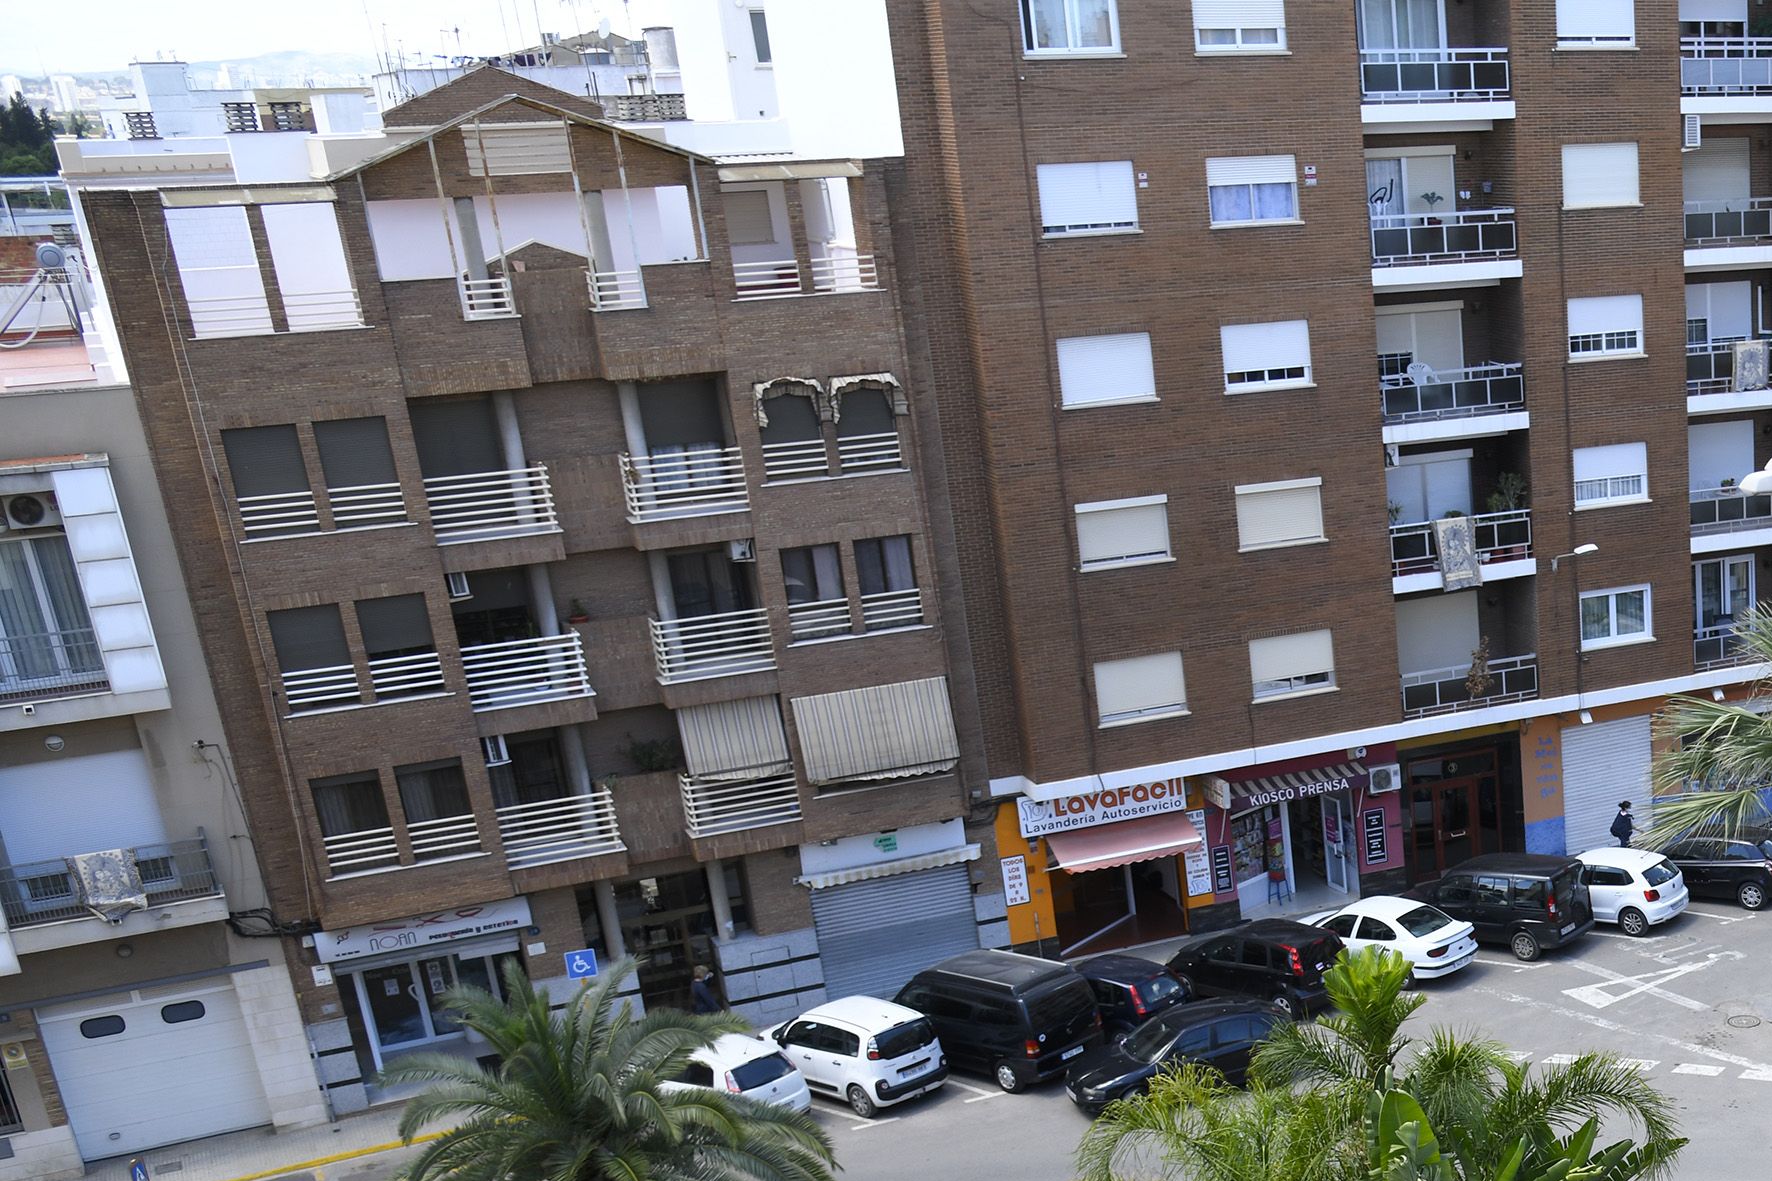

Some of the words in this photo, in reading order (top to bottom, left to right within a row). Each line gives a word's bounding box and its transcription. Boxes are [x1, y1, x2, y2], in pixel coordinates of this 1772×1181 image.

[1250, 788, 1295, 807] KIOSCO
[1299, 778, 1350, 797] PRENSA
[1025, 814, 1095, 834] Lavandería
[1101, 799, 1182, 821] Autoservicio
[1002, 858, 1023, 866] TODOS
